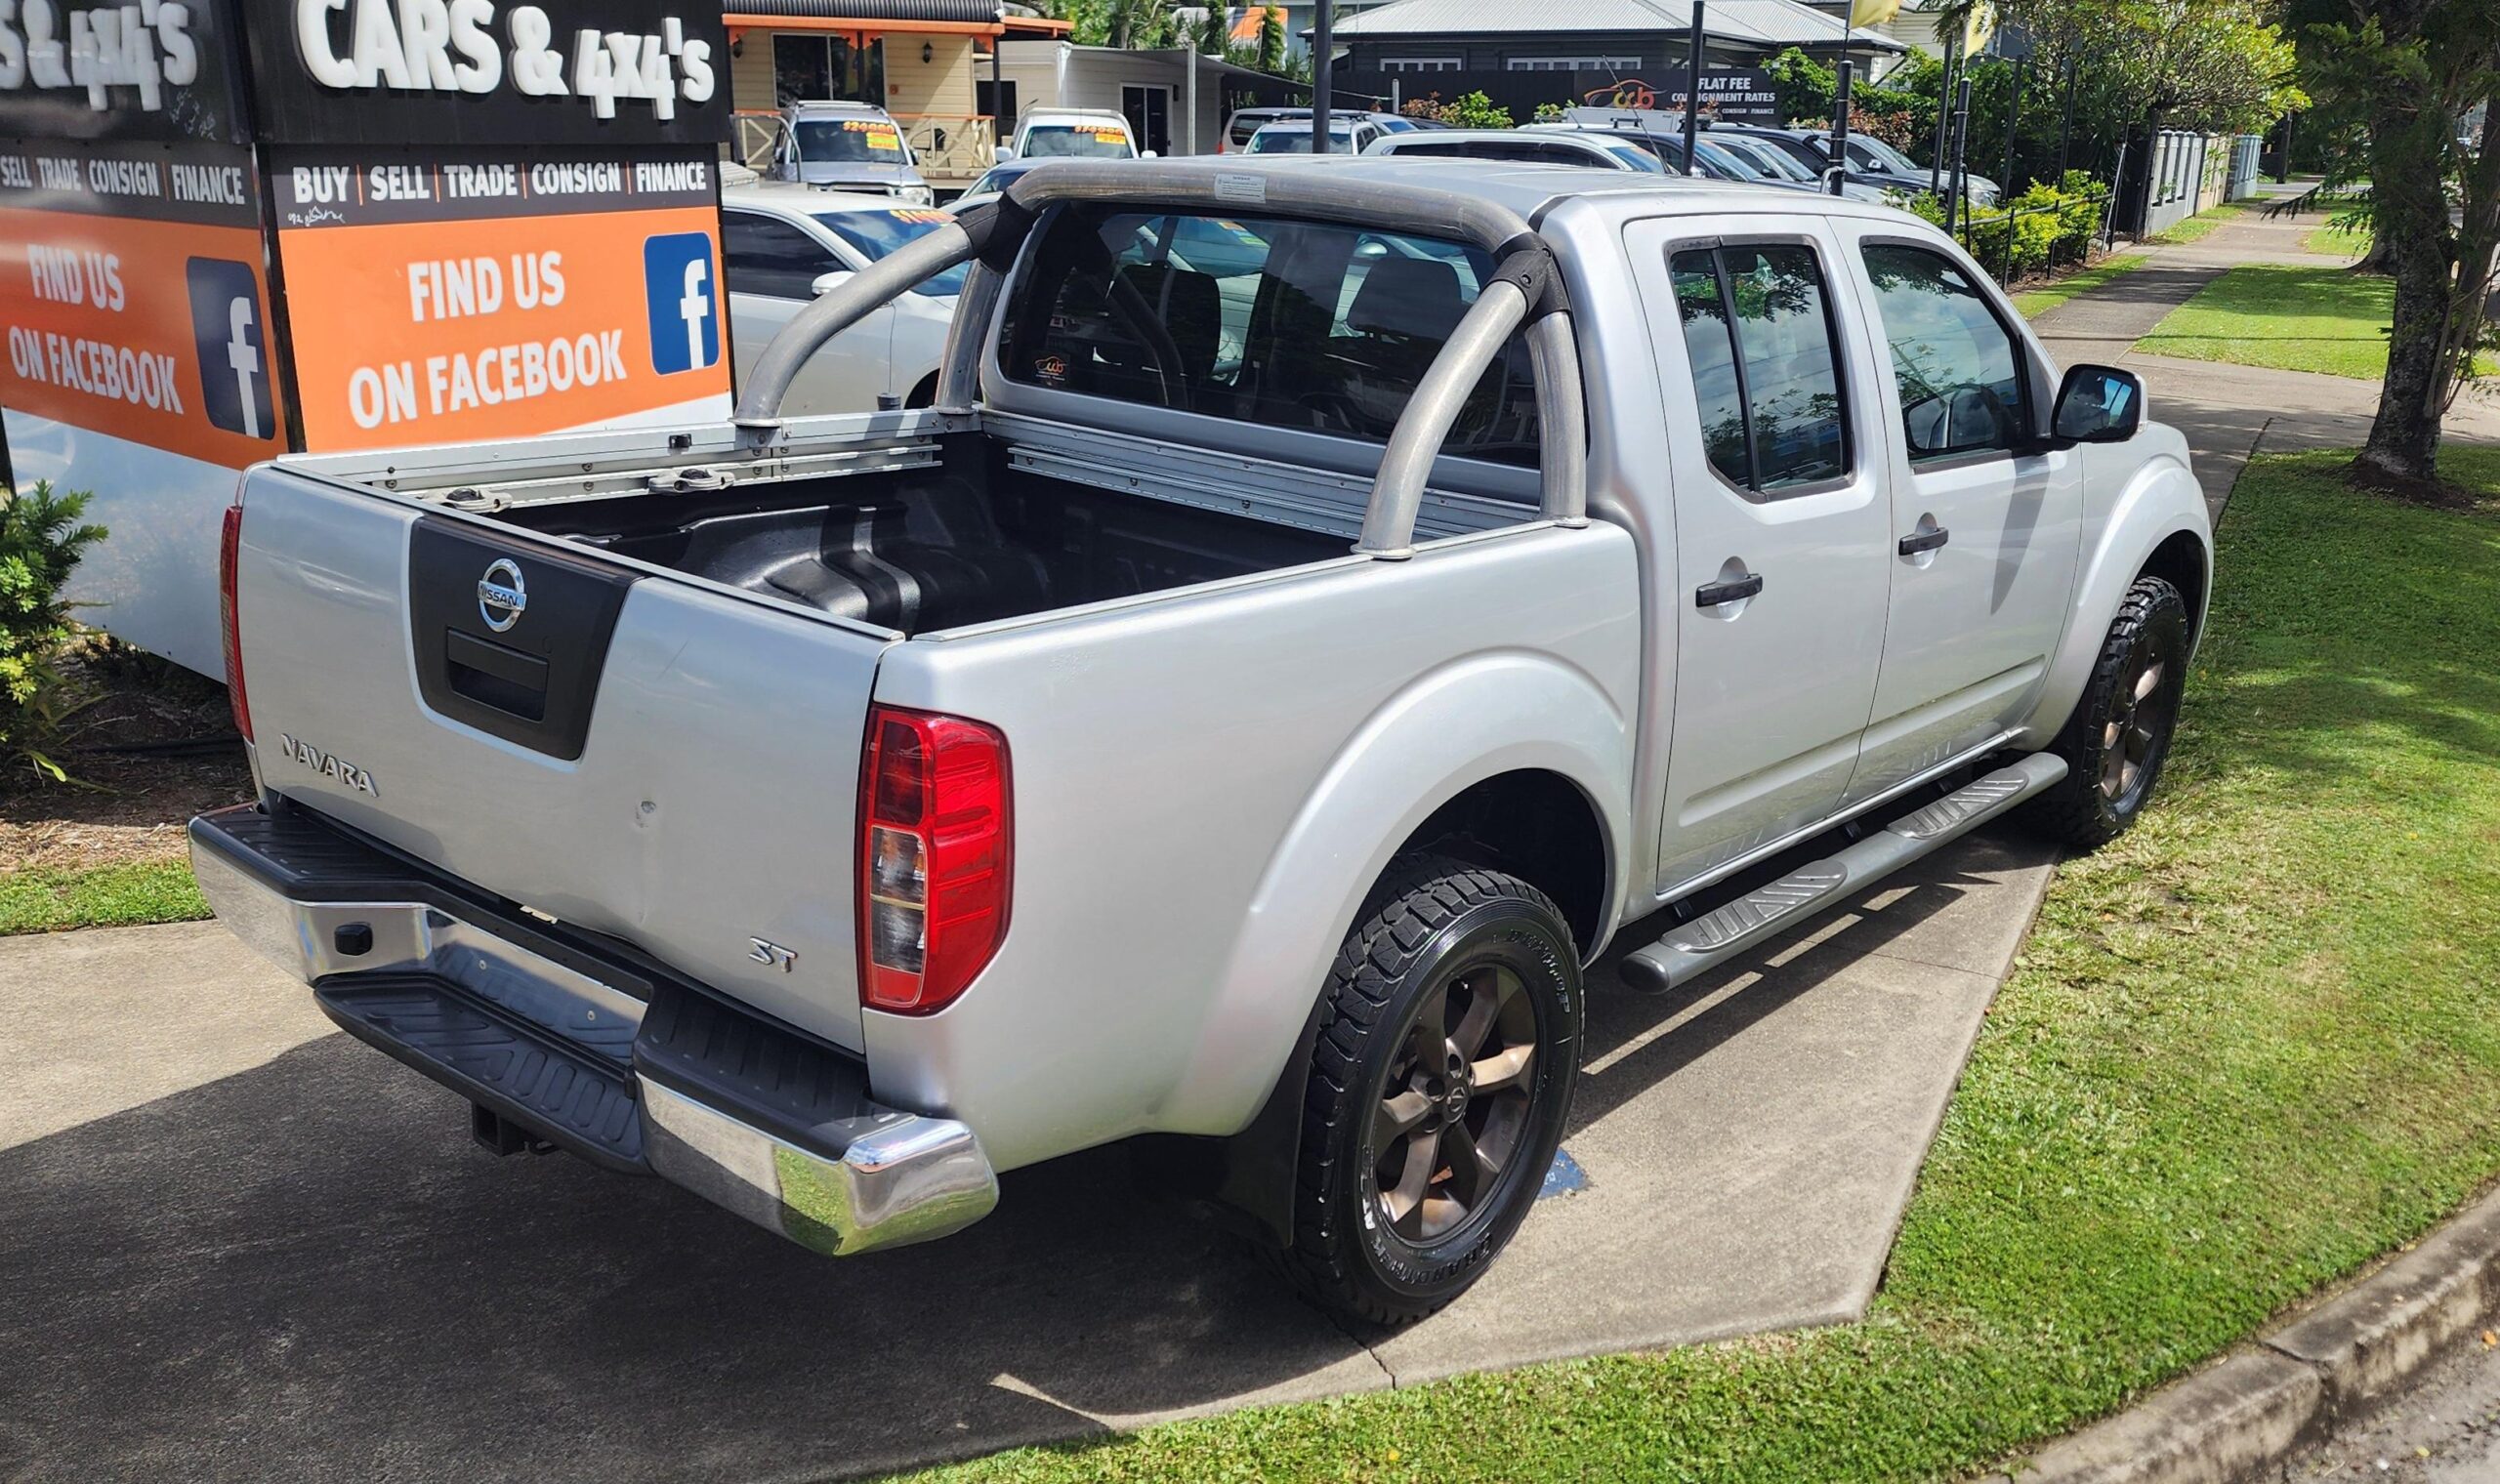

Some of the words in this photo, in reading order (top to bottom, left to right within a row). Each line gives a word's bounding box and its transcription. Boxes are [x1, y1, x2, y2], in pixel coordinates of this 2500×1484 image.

[22, 0, 72, 89] &
[297, 0, 502, 94] CARS
[510, 6, 569, 96] &
[1672, 92, 1743, 103] COIGNMENT
[1744, 92, 1775, 102] RATES
[1698, 78, 1727, 90] FLAT
[1729, 78, 1751, 90] FEE
[0, 155, 32, 188] SELL
[36, 157, 82, 191] TRADE
[88, 159, 159, 196] CONSIGN
[171, 164, 245, 205] FINANCE
[293, 166, 350, 203] BUY
[370, 164, 430, 201] SELL
[443, 164, 518, 198] TRADE
[531, 162, 620, 195] CONSIGN
[636, 161, 706, 192] FINANCE
[26, 243, 84, 305] FIND
[84, 251, 125, 312] US
[407, 257, 502, 322] FIND
[512, 251, 565, 309] US
[8, 325, 46, 383] ON
[46, 332, 184, 415] FACEBOOK
[348, 360, 418, 429] ON
[427, 329, 627, 415] FACEBOOK
[479, 583, 518, 606] NISSAN
[280, 732, 379, 798] NAVARA
[748, 935, 798, 973] ST
